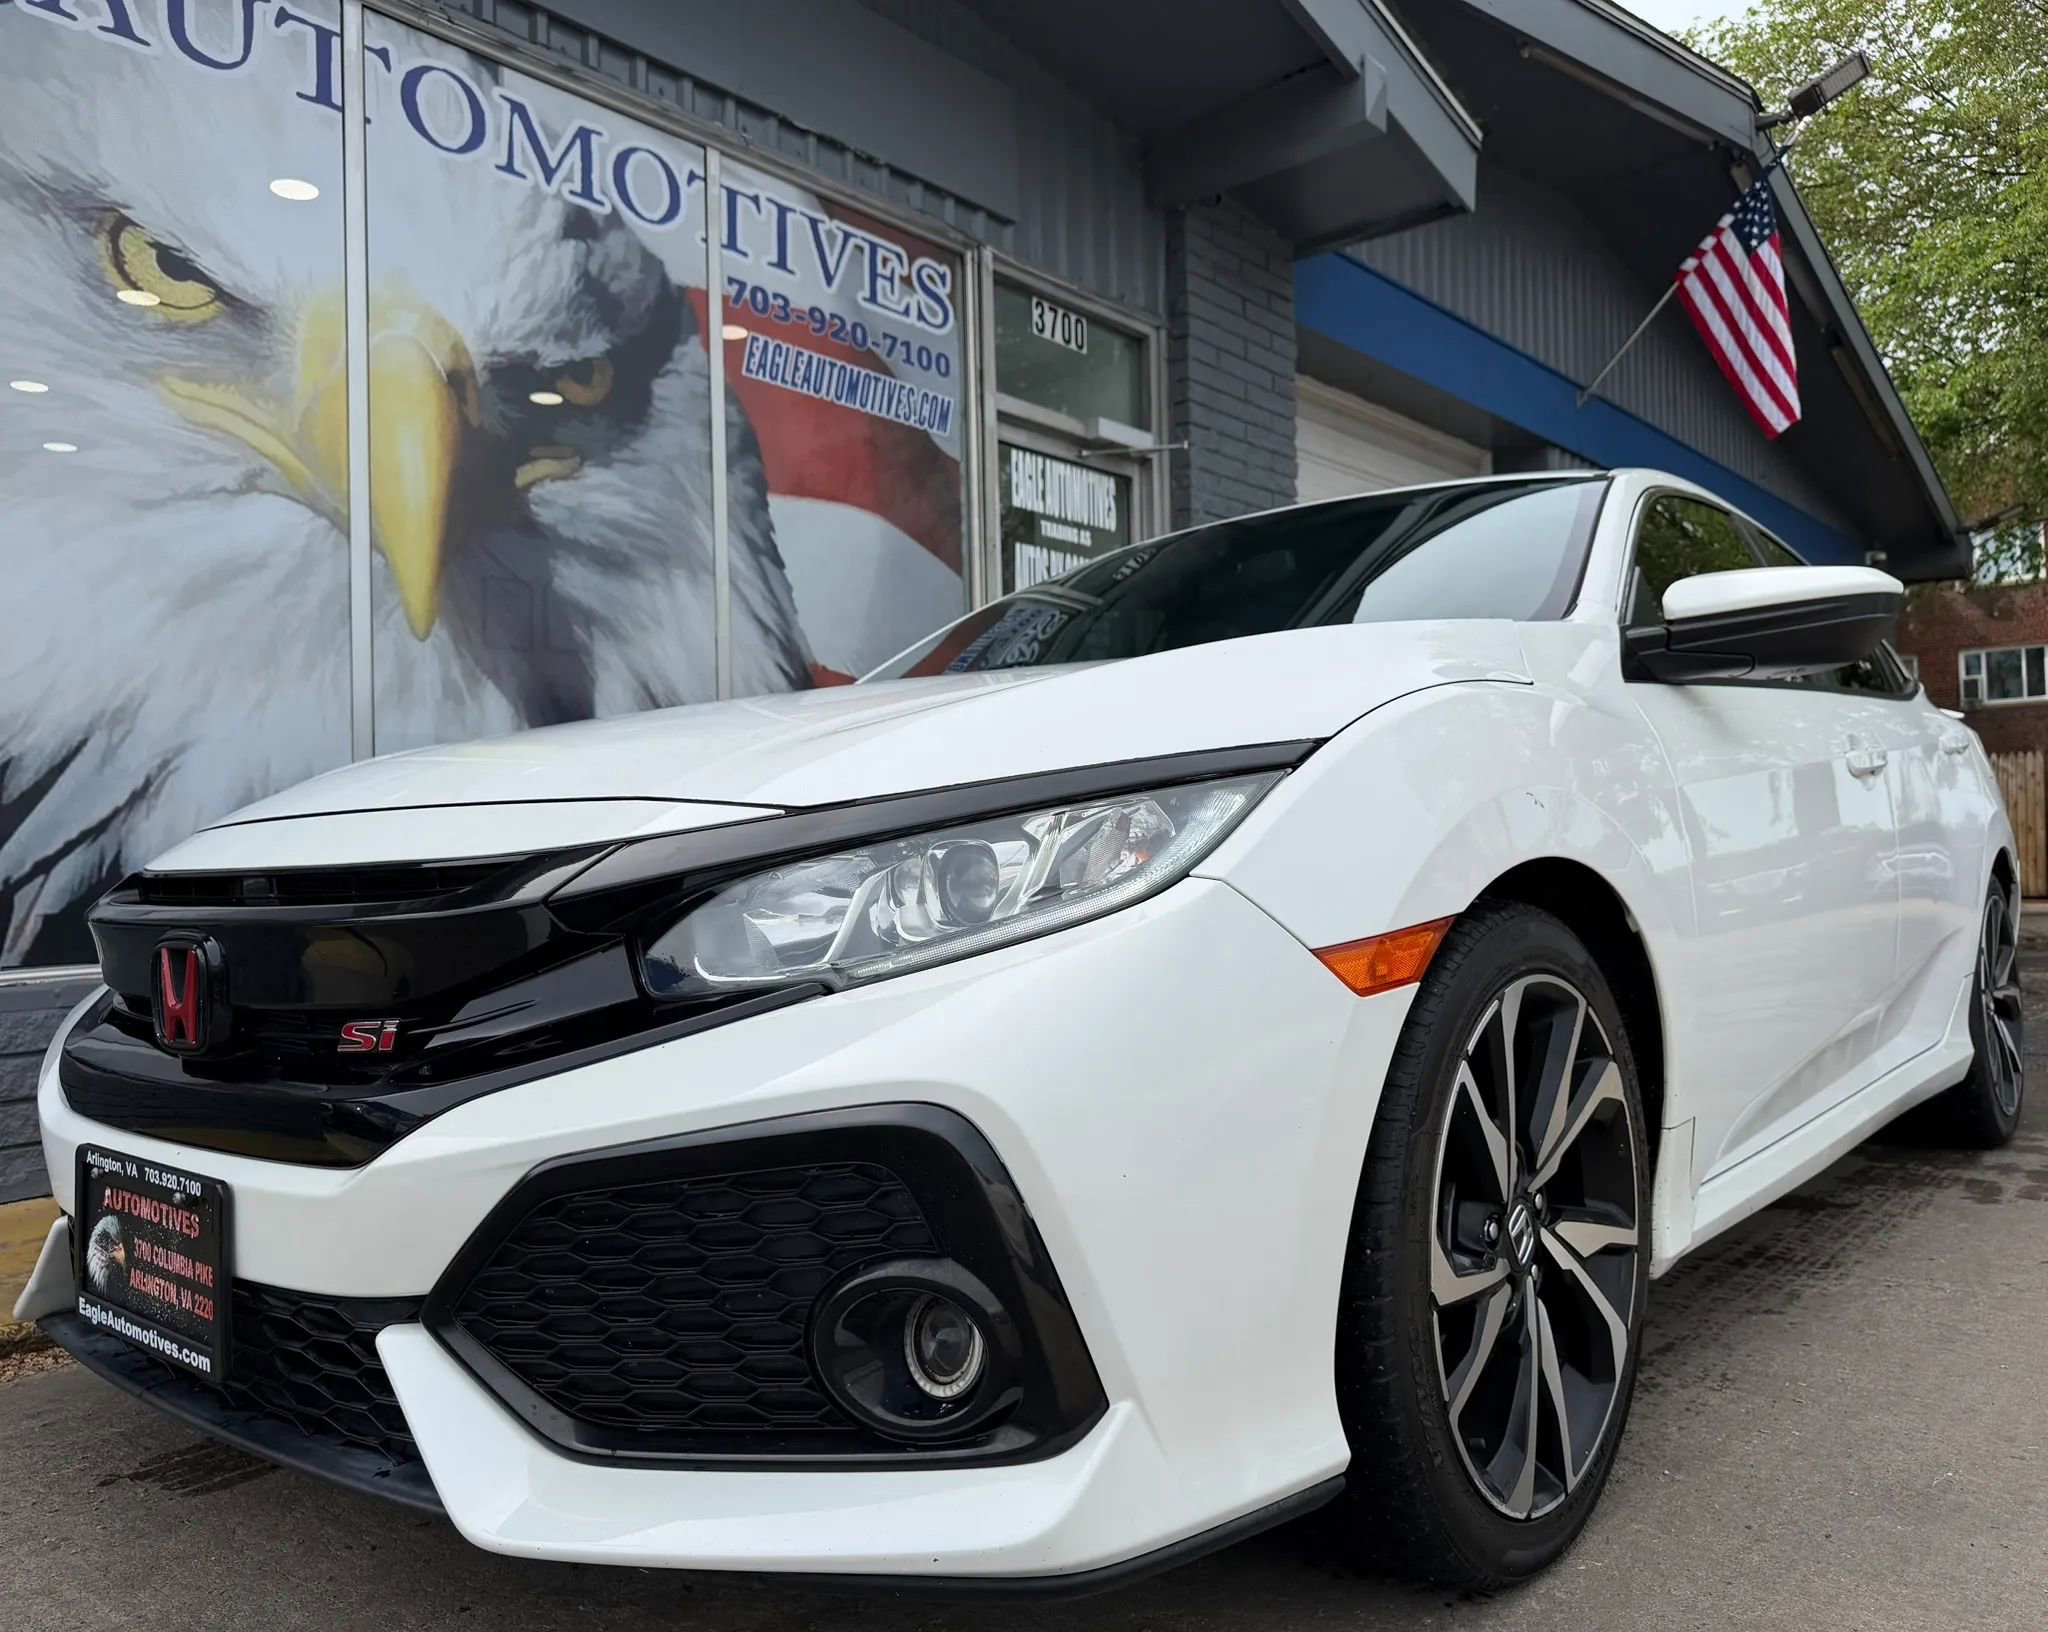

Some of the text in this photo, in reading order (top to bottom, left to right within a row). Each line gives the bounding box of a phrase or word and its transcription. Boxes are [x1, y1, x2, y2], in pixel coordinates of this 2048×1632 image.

[727, 275, 951, 379] 703-920-7100
[1033, 300, 1086, 352] 3700
[743, 334, 953, 434] EAGLEAUTOMOTIVES.COM
[337, 1017, 400, 1052] Si
[85, 1149, 202, 1198] Arlington, VA 703.920.7100
[103, 1186, 201, 1239] AUTOMOTIVES
[152, 1244, 194, 1281] COLUMBIA
[194, 1261, 214, 1288] PIKE
[180, 1286, 193, 1312] VA
[78, 1296, 212, 1374] EagleAutomotives.com
